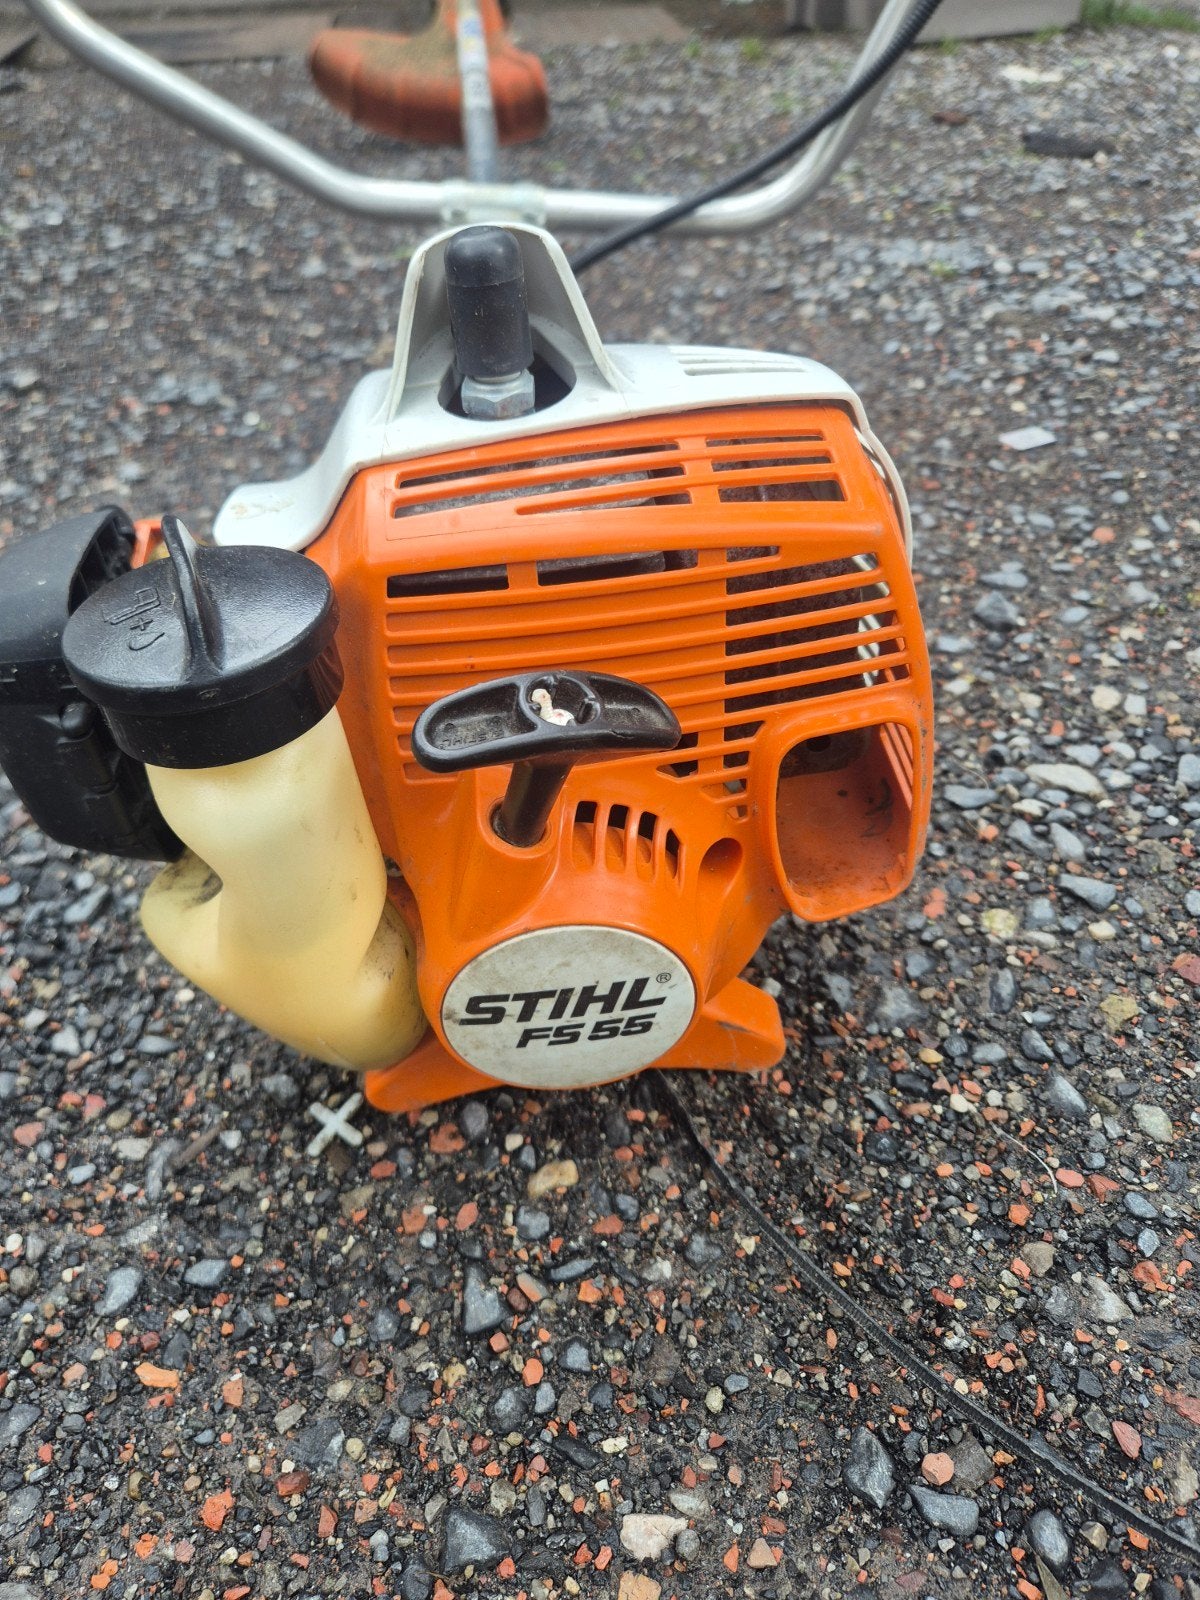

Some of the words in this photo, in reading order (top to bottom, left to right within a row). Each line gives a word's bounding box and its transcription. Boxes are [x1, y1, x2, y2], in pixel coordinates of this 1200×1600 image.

[459, 977, 667, 1026] STIHL
[516, 1023, 584, 1049] FS
[587, 1013, 657, 1041] 55
